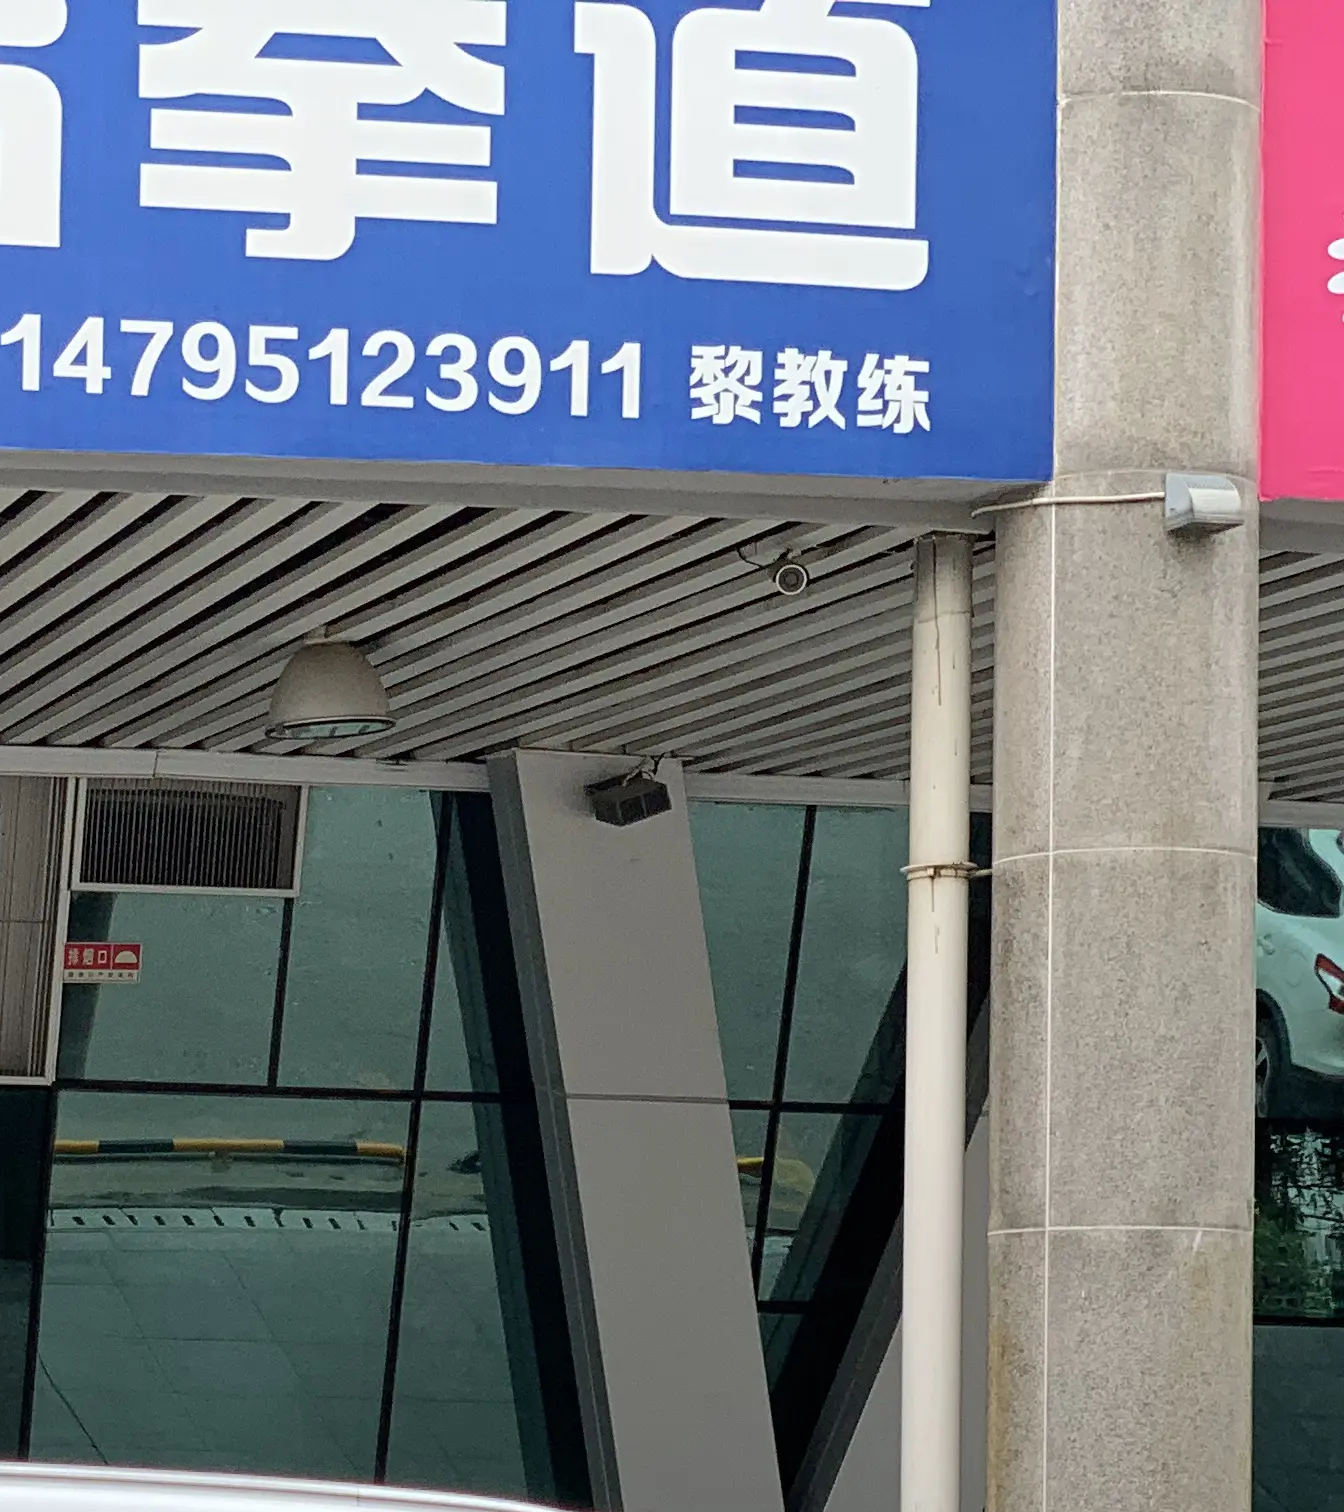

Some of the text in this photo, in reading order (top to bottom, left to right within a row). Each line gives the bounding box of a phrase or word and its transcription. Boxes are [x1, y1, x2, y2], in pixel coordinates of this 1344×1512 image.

[0, 313, 641, 419] 14795123911
[689, 344, 931, 434] 黎教练
